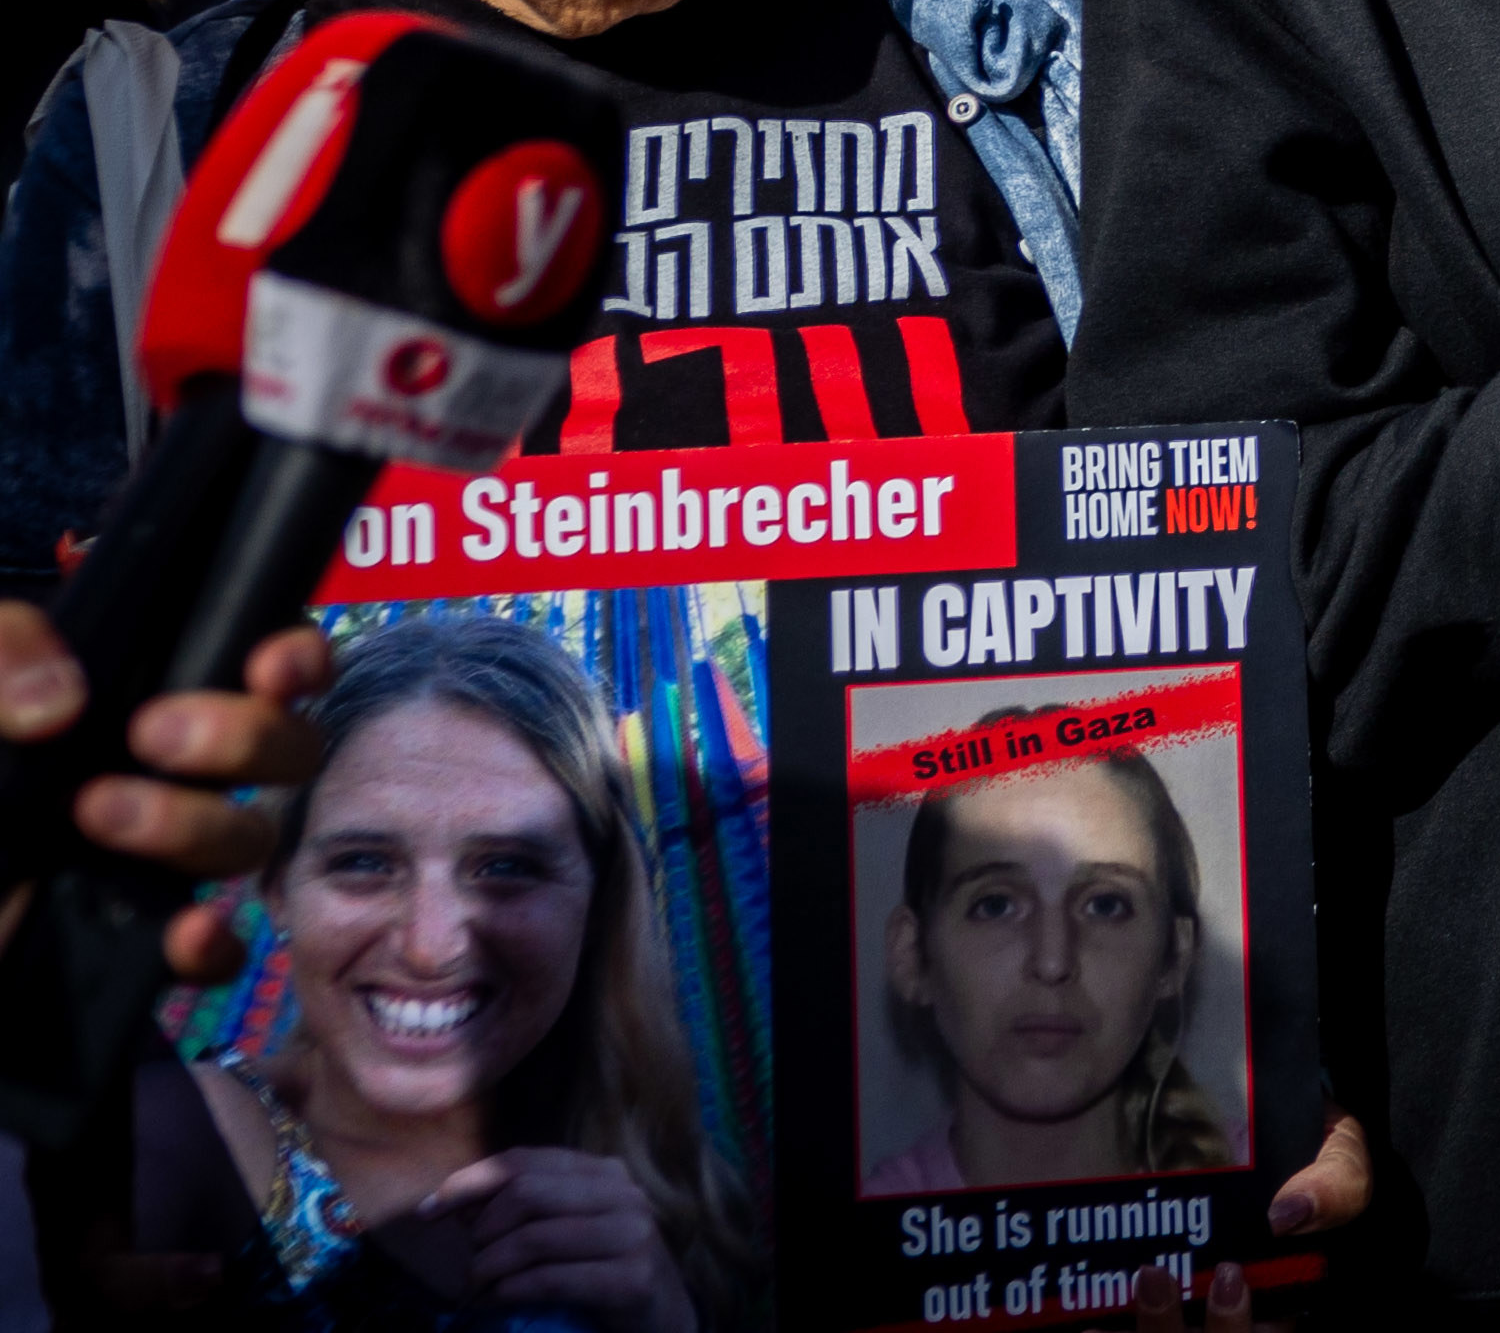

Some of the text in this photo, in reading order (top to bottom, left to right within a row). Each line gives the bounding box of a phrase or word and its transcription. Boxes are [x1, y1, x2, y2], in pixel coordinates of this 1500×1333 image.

[625, 112, 936, 222] מחזירים
[603, 215, 949, 320] אותם הב
[1061, 437, 1258, 492] BRING THEM
[461, 457, 954, 562] Steinbrecher
[1063, 485, 1258, 540] HOME NOW!
[830, 567, 1257, 674] IN CAPTIVITY
[912, 701, 1157, 780] Still in Gaza
[900, 1188, 1211, 1257] She is running
[924, 1281, 991, 1323] out
[1006, 1264, 1046, 1315] of
